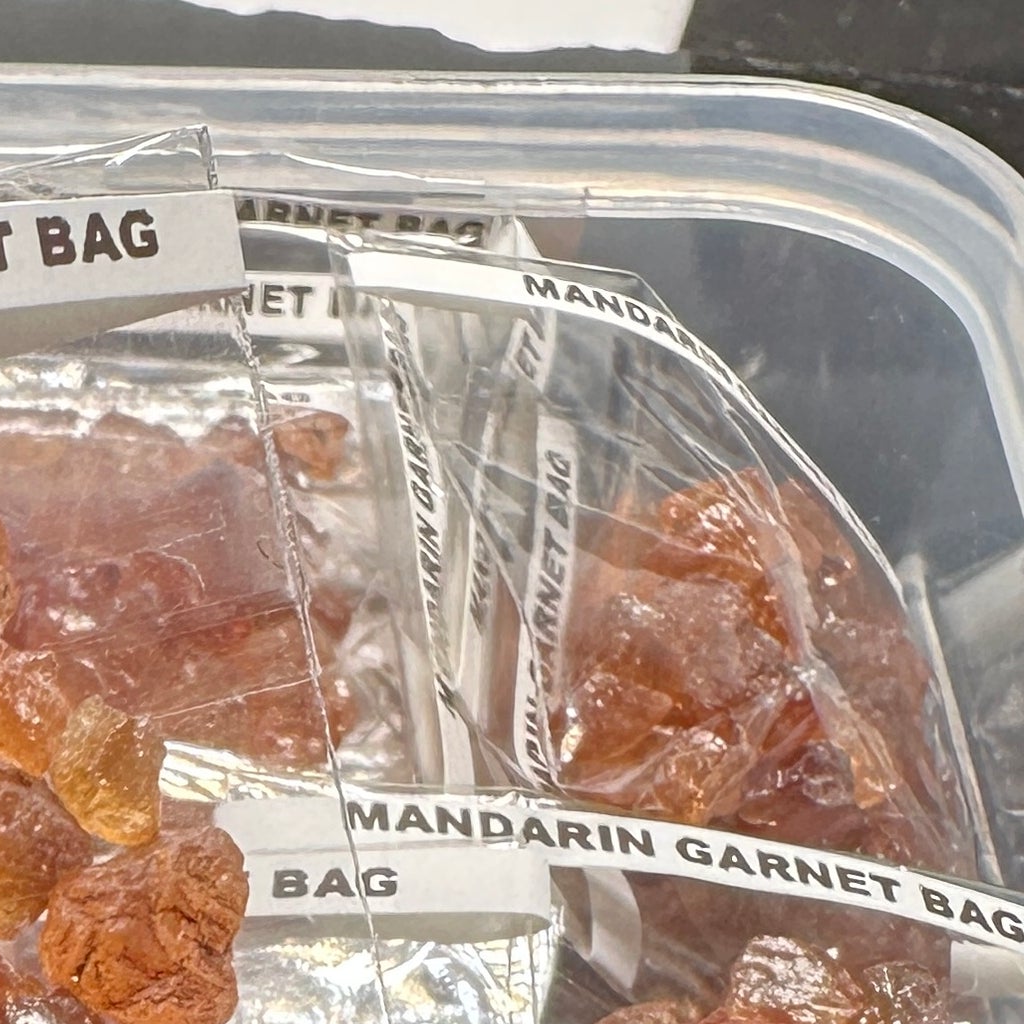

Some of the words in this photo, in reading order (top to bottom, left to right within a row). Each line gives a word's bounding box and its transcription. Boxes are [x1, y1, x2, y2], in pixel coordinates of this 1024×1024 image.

[39, 208, 160, 267] BAG
[273, 867, 398, 897] BAG
[347, 800, 656, 858] MANDARIN
[676, 838, 901, 903] GARNET
[919, 884, 1024, 943] BAG
